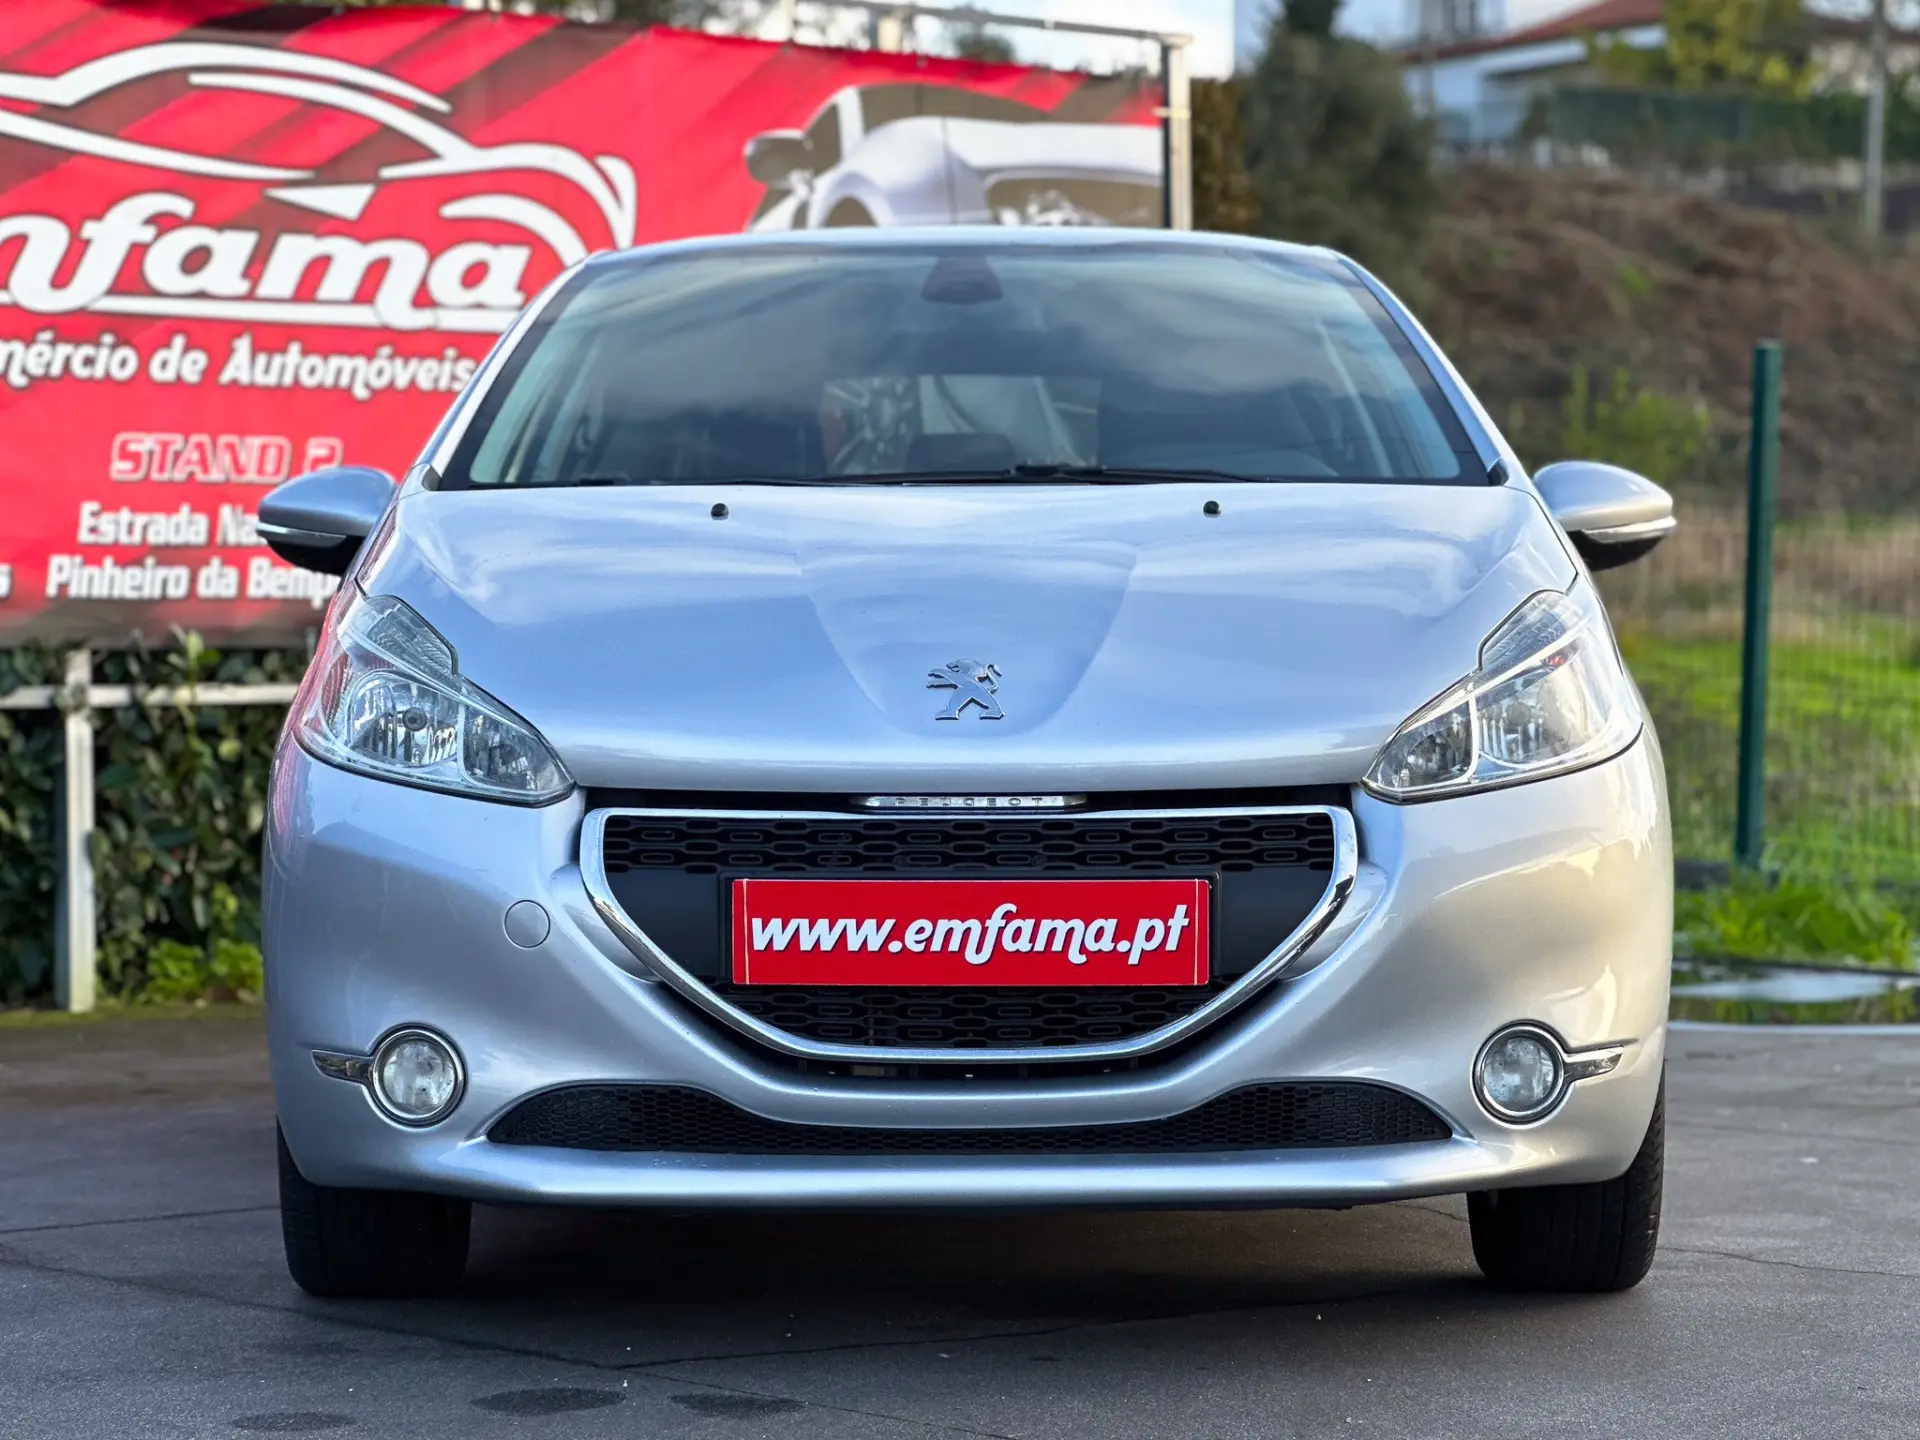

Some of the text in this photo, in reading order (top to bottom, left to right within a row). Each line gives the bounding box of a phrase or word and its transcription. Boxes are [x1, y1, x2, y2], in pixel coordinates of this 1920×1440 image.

[148, 333, 208, 384] de
[217, 331, 477, 401] Automóveis
[108, 432, 292, 482] STAND
[77, 500, 209, 546] Estrada
[46, 553, 190, 600] Pinheiro
[196, 555, 239, 600] da
[750, 902, 1189, 965] www.emfama.pt
